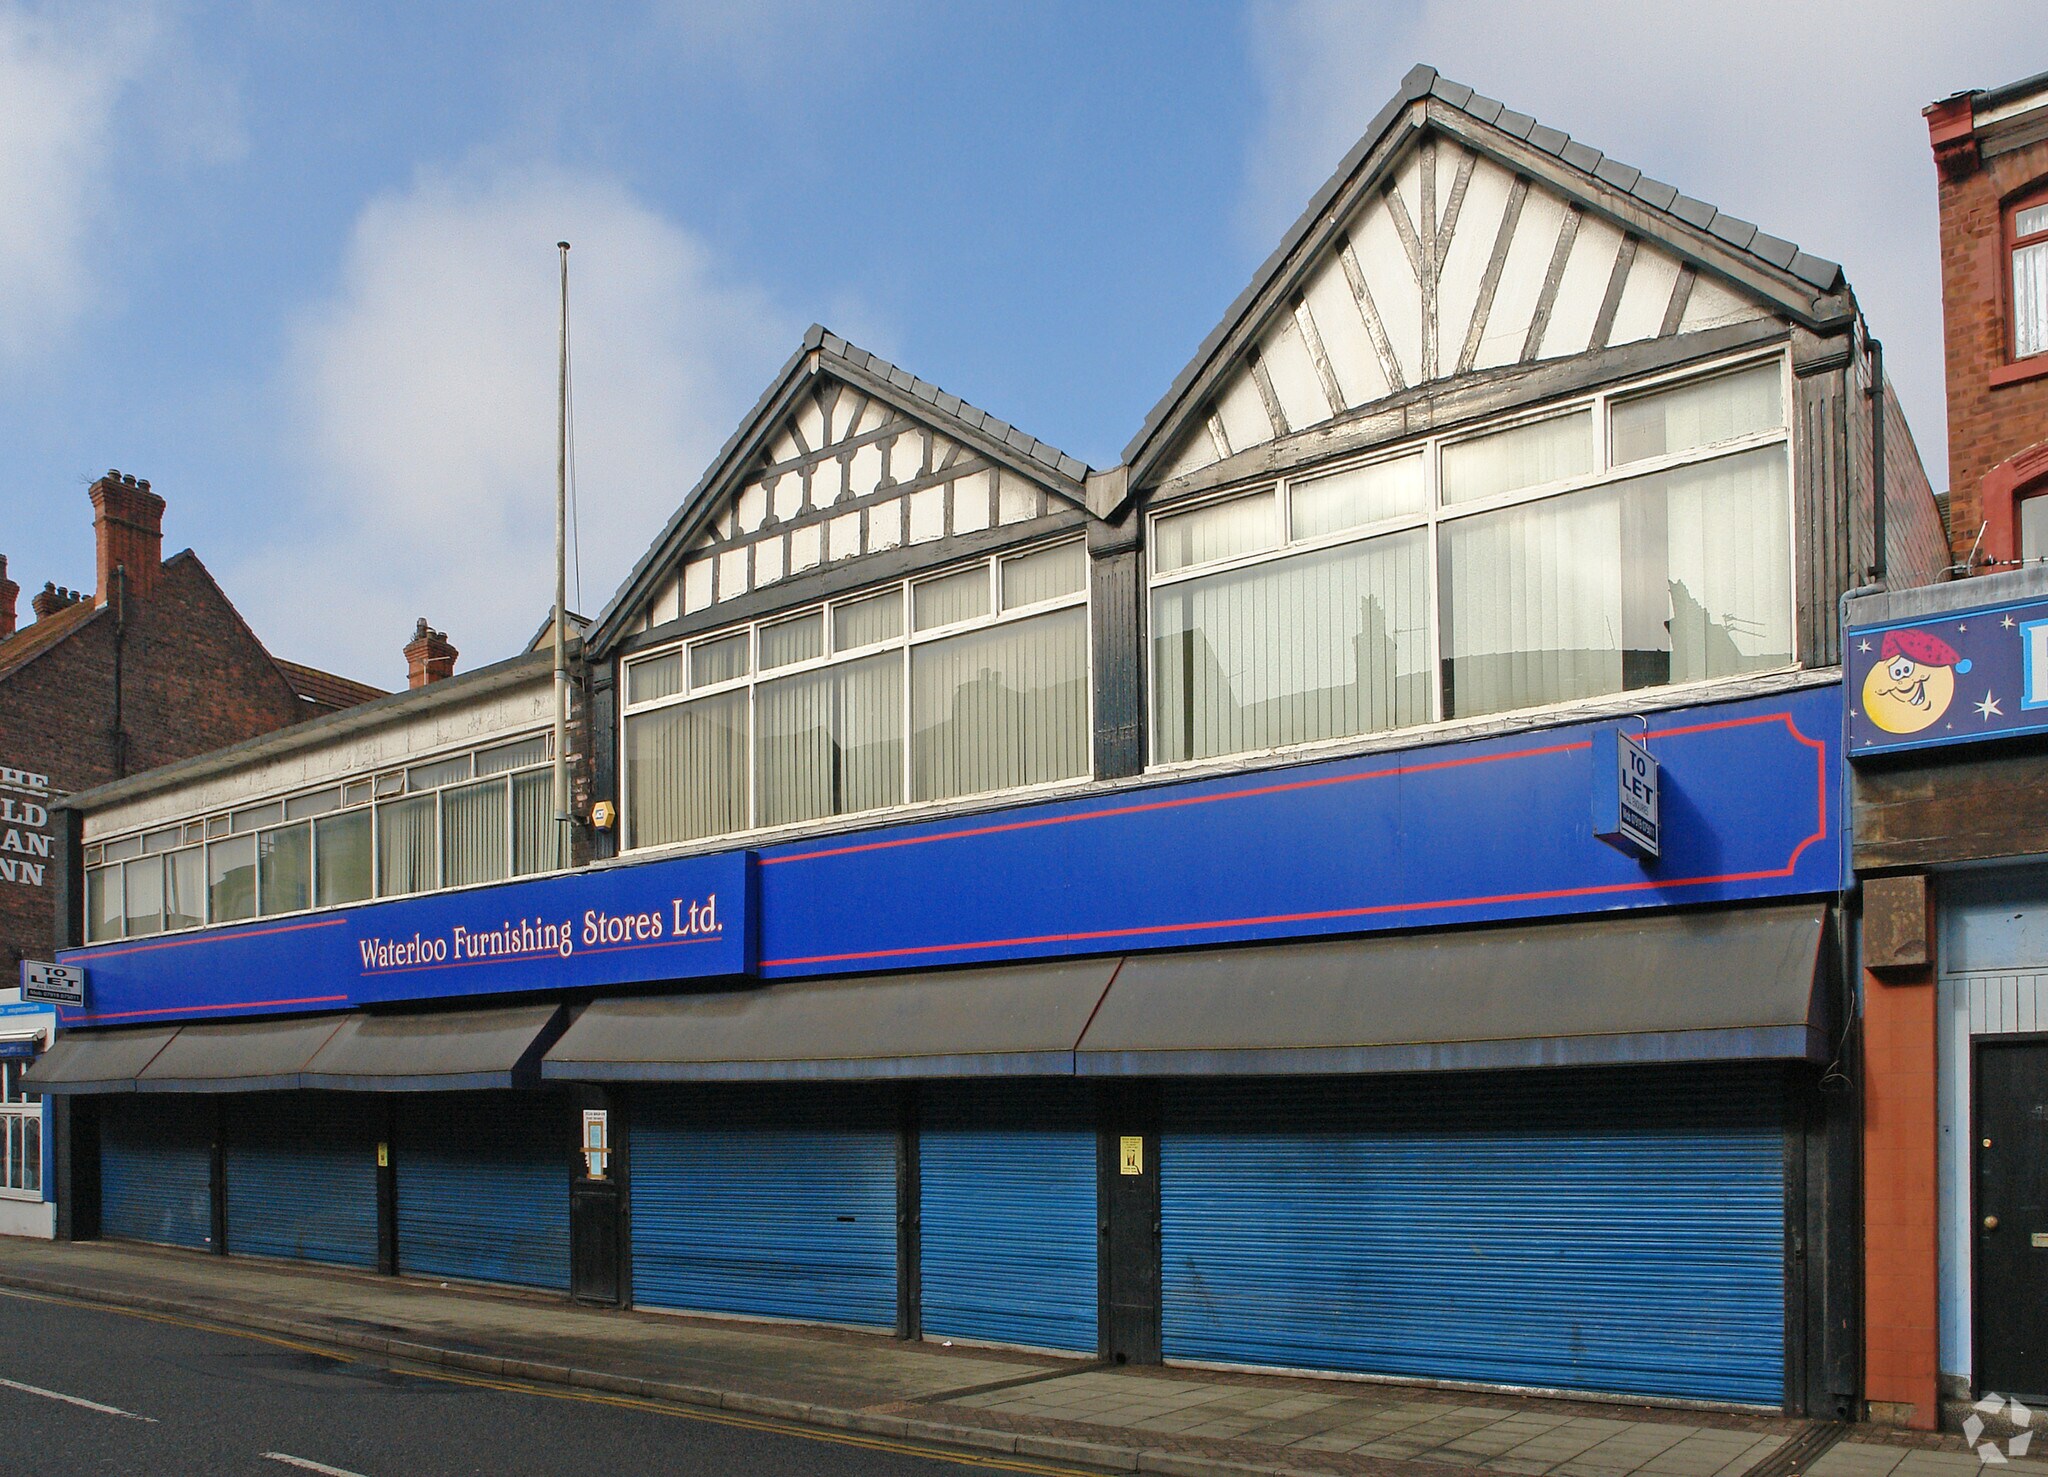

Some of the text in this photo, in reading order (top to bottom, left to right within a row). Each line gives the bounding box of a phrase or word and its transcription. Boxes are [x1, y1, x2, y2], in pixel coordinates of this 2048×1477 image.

[1629, 749, 1646, 777] TO
[1622, 768, 1653, 805] LET
[360, 892, 723, 969] Waterloo Furnishing Stores Ltd.
[31, 975, 79, 987] LET
[43, 967, 67, 977] TO
